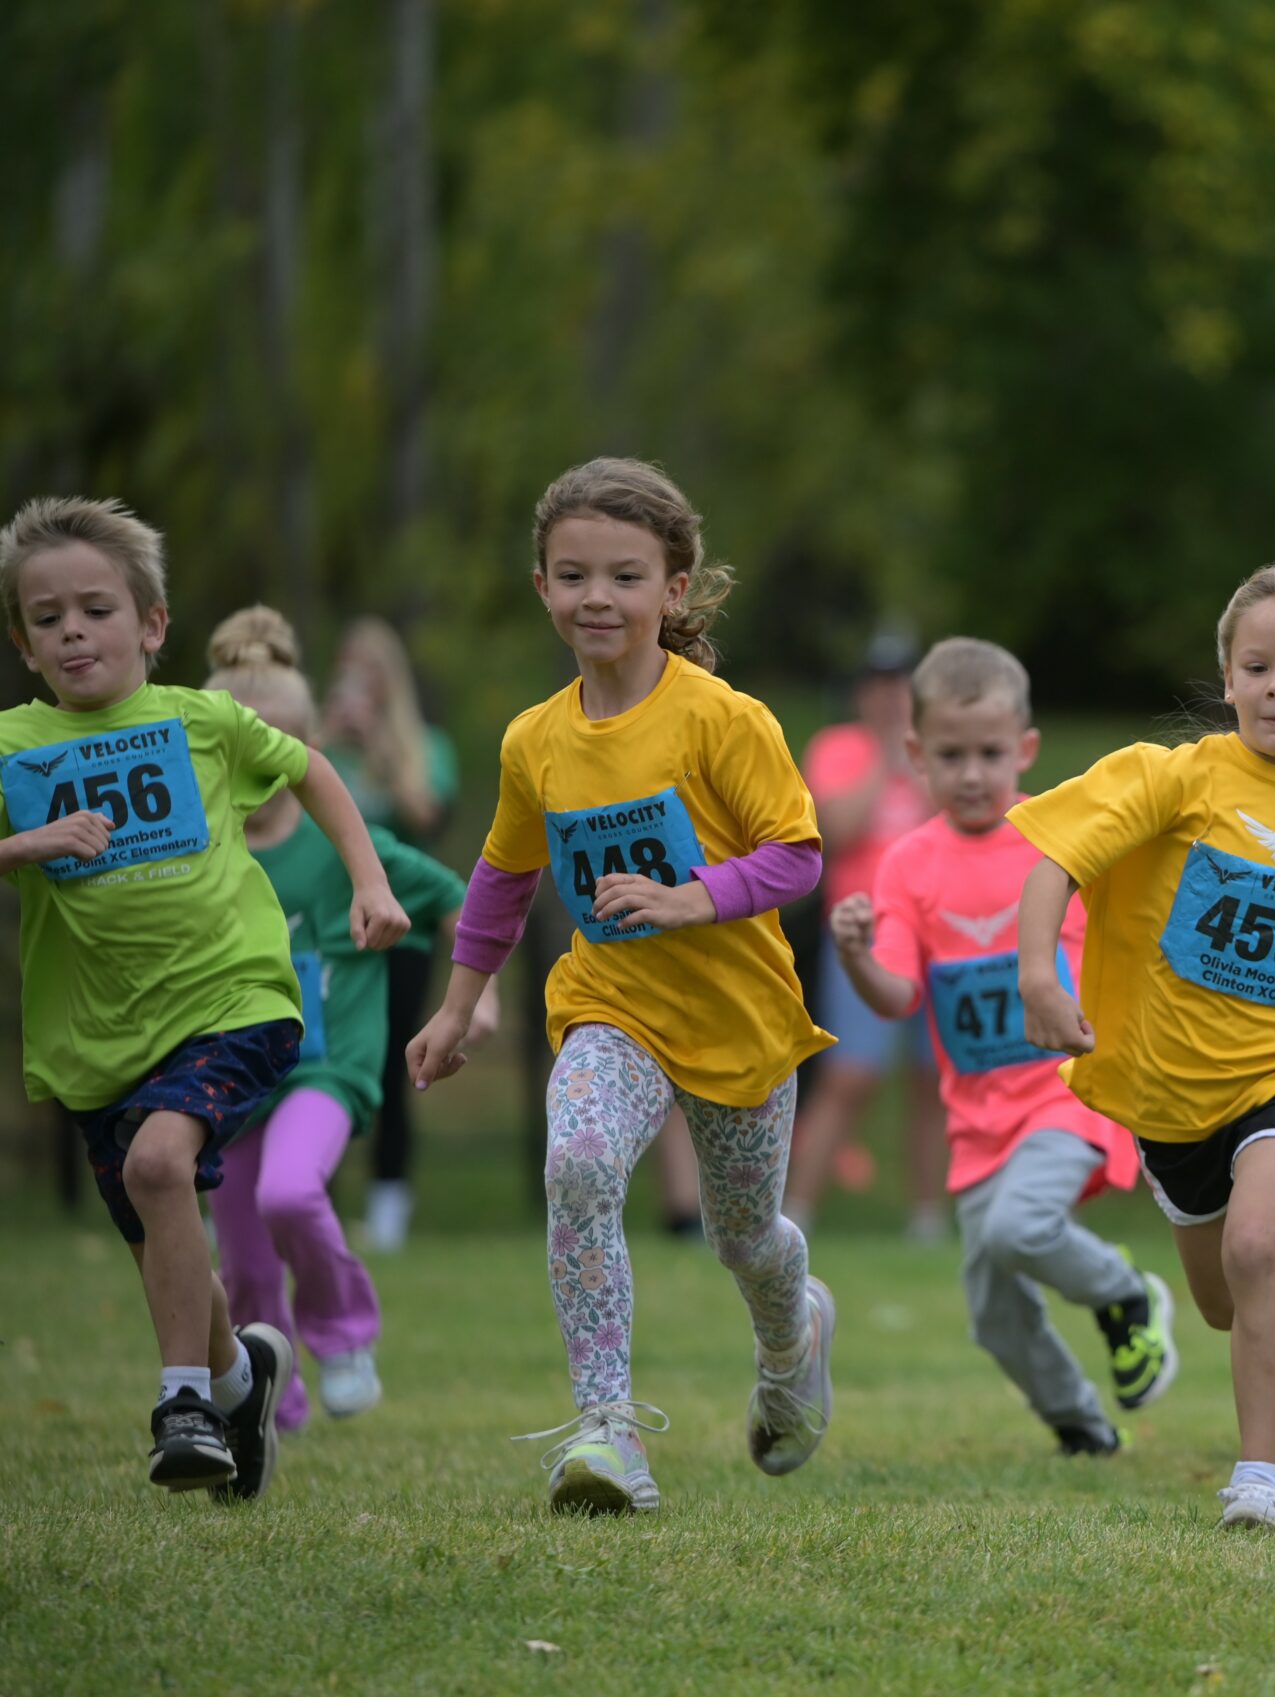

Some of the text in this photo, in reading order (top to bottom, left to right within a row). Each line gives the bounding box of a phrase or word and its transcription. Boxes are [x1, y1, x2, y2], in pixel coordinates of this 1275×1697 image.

[79, 728, 170, 760] VELOCITY
[586, 801, 666, 832] VELOCITY
[108, 827, 173, 849] hambers
[74, 854, 107, 872] Point
[110, 850, 128, 862] XC
[131, 837, 198, 859] Elementary
[149, 863, 191, 879] FIELD
[1200, 953, 1242, 977] Olivia
[1202, 970, 1255, 995] Clinton
[956, 988, 1022, 1040] 47
